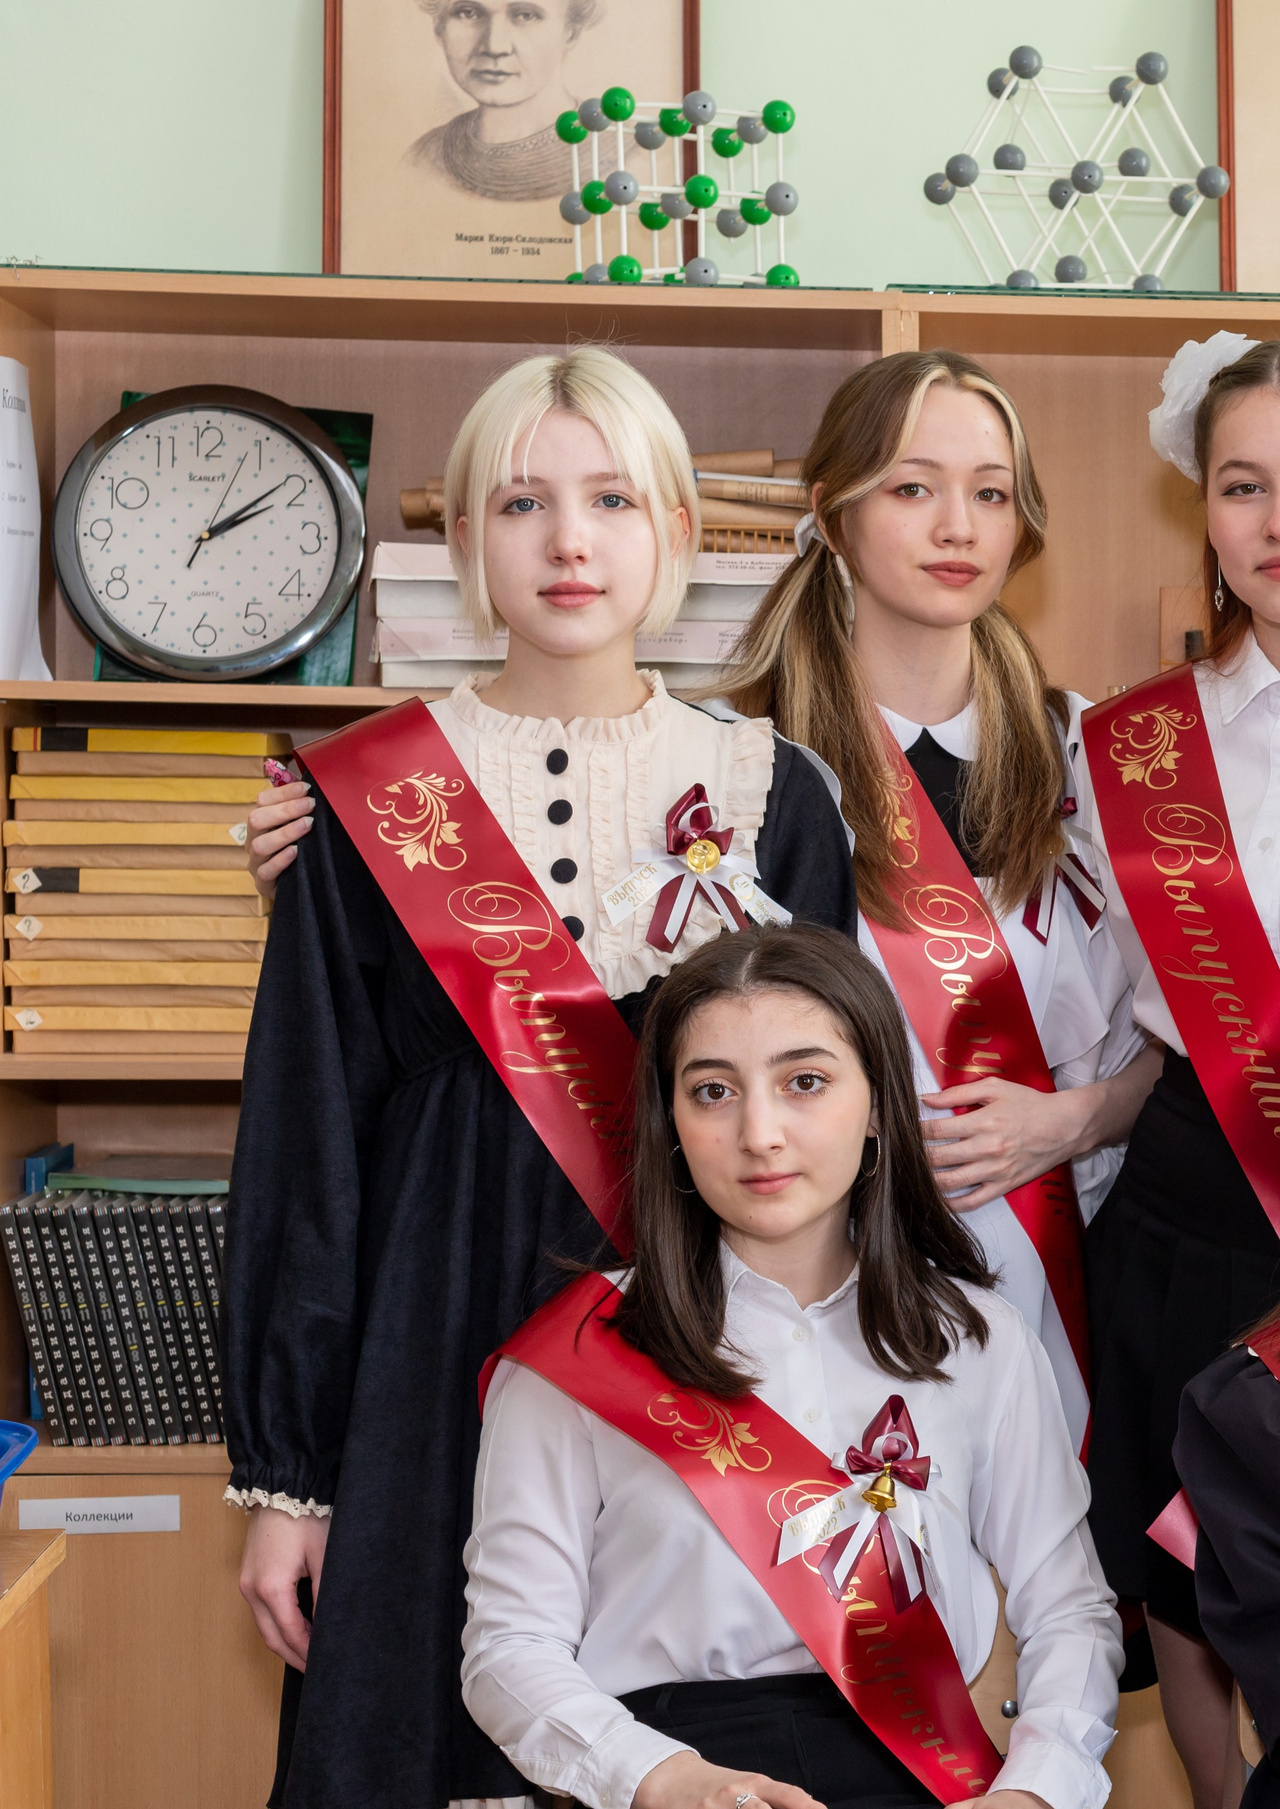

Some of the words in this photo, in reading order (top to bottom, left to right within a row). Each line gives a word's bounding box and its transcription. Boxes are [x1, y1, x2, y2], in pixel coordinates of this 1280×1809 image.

[455, 233, 484, 243] Мария
[490, 246, 509, 255] 1867
[521, 247, 540, 256] 1934
[153, 436, 175, 468] 11
[193, 426, 223, 457] 12
[254, 440, 262, 471] 1
[108, 477, 150, 510] 10
[188, 475, 227, 483] SCARLETT
[283, 474, 307, 506] 2
[89, 518, 113, 552] 9
[299, 521, 322, 555] 3
[105, 566, 129, 600] 8
[278, 568, 304, 602] 4
[148, 602, 167, 634] 7
[192, 614, 217, 647] 6
[242, 602, 267, 636] 5
[607, 863, 658, 906] ВЫПУСК
[628, 880, 657, 907] 2022
[5, 1227, 26, 1290] химия
[23, 1226, 44, 1289] химия
[41, 1227, 63, 1289] химия
[60, 1227, 81, 1290] химия
[82, 1227, 103, 1289] химия
[119, 1226, 140, 1288] химия
[139, 1224, 160, 1287] химия
[157, 1225, 179, 1287] химия
[176, 1225, 197, 1288] химия
[195, 1225, 216, 1287] химия
[28, 1324, 58, 1426] задачник
[47, 1323, 77, 1425] задачник
[65, 1323, 96, 1425] задачник
[84, 1323, 115, 1425] задачник
[106, 1323, 136, 1425] задачник
[142, 1322, 173, 1424] задачник
[163, 1321, 192, 1422] задачник
[181, 1321, 211, 1423] задачник
[65, 1511, 133, 1523] Коллекции
[788, 1495, 847, 1537] ВЫПУСК
[809, 1518, 839, 1544] 2022
